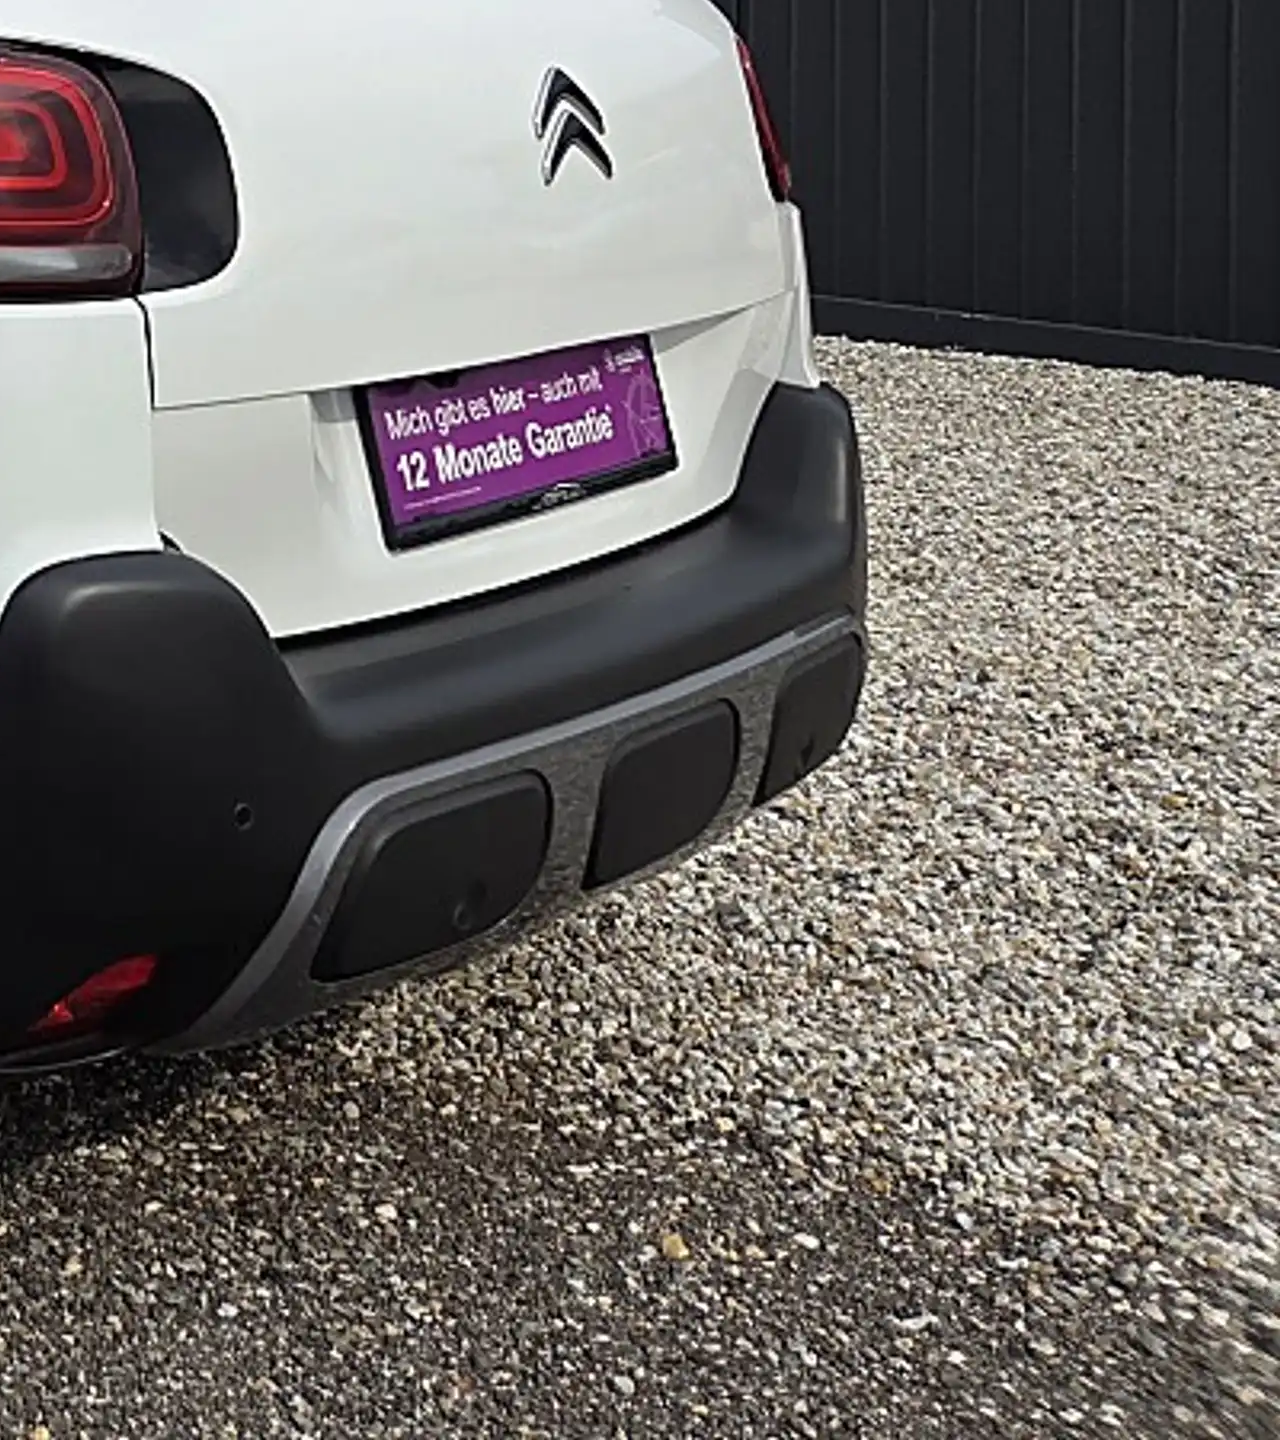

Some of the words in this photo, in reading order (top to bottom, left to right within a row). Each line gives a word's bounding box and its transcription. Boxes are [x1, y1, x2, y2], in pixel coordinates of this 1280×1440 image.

[384, 406, 433, 440] Mich
[435, 398, 469, 437] gibt
[468, 396, 490, 421] es
[490, 386, 526, 415] hier
[540, 372, 578, 403] auch
[577, 365, 603, 395] mit
[397, 451, 430, 491] 12
[433, 433, 523, 485] Monate
